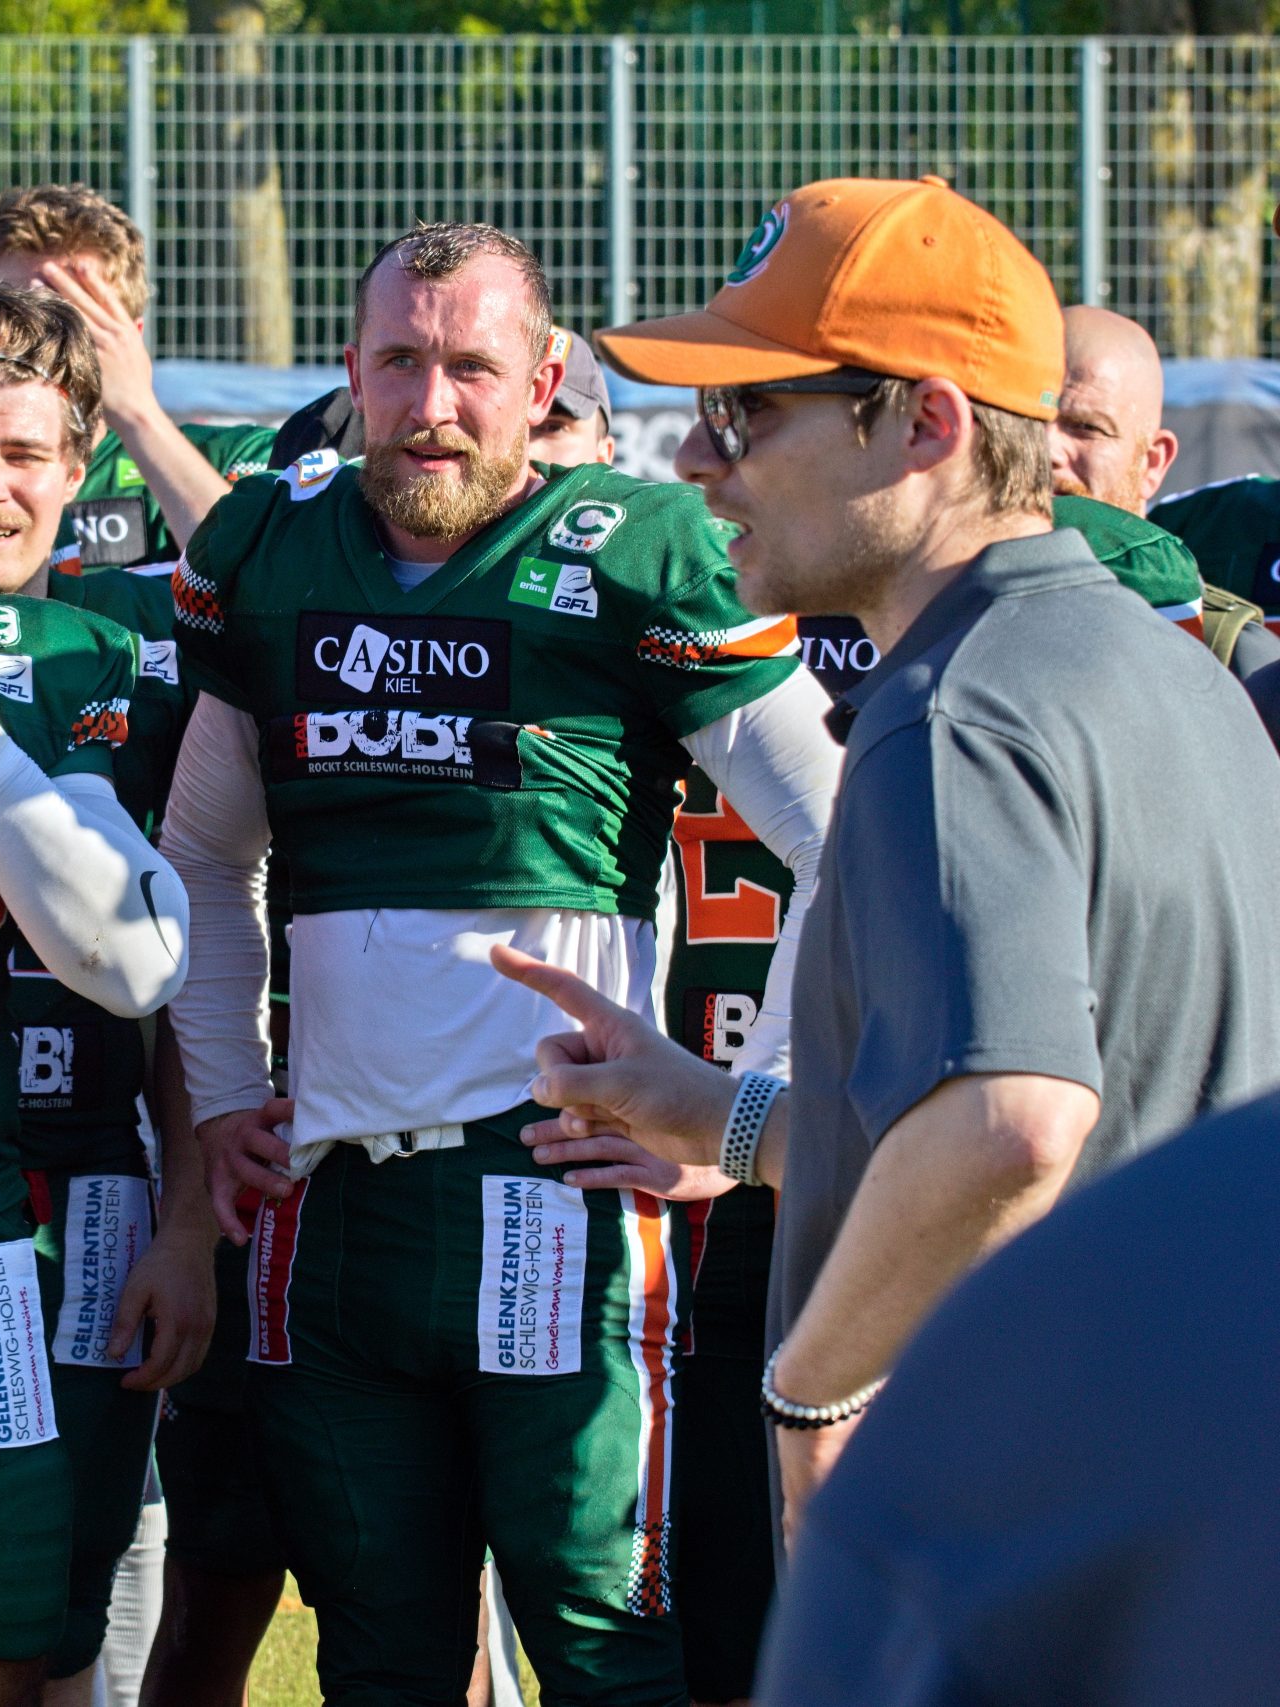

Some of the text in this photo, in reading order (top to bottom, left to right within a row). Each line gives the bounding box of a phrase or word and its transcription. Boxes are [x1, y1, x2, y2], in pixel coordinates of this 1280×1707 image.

[564, 505, 617, 536] C
[520, 581, 548, 594] erima
[554, 595, 594, 613] GFL
[314, 636, 490, 678] CASINO
[801, 636, 881, 671] INO
[385, 677, 422, 694] KIEL
[294, 713, 308, 759] RAD
[308, 761, 474, 779] ROCKT SCHLESWIG-HOLSTEIN
[703, 992, 716, 1061] RADIO
[20, 1026, 75, 1094] B!
[71, 1180, 103, 1361] GELENKZENTRUM
[91, 1179, 120, 1362] SCHLESWIG-HOLSTEIN
[126, 1221, 138, 1276] rwärts.
[498, 1181, 522, 1369] GELENKZENTRUM
[520, 1181, 543, 1369] SCHLESWIG-HOLSTEIN
[257, 1208, 276, 1355] DAS FUTTERHAUS
[545, 1223, 565, 1370] Gemeinsam vorwärts.
[19, 1286, 46, 1438] Gemeinsam vorwärts.
